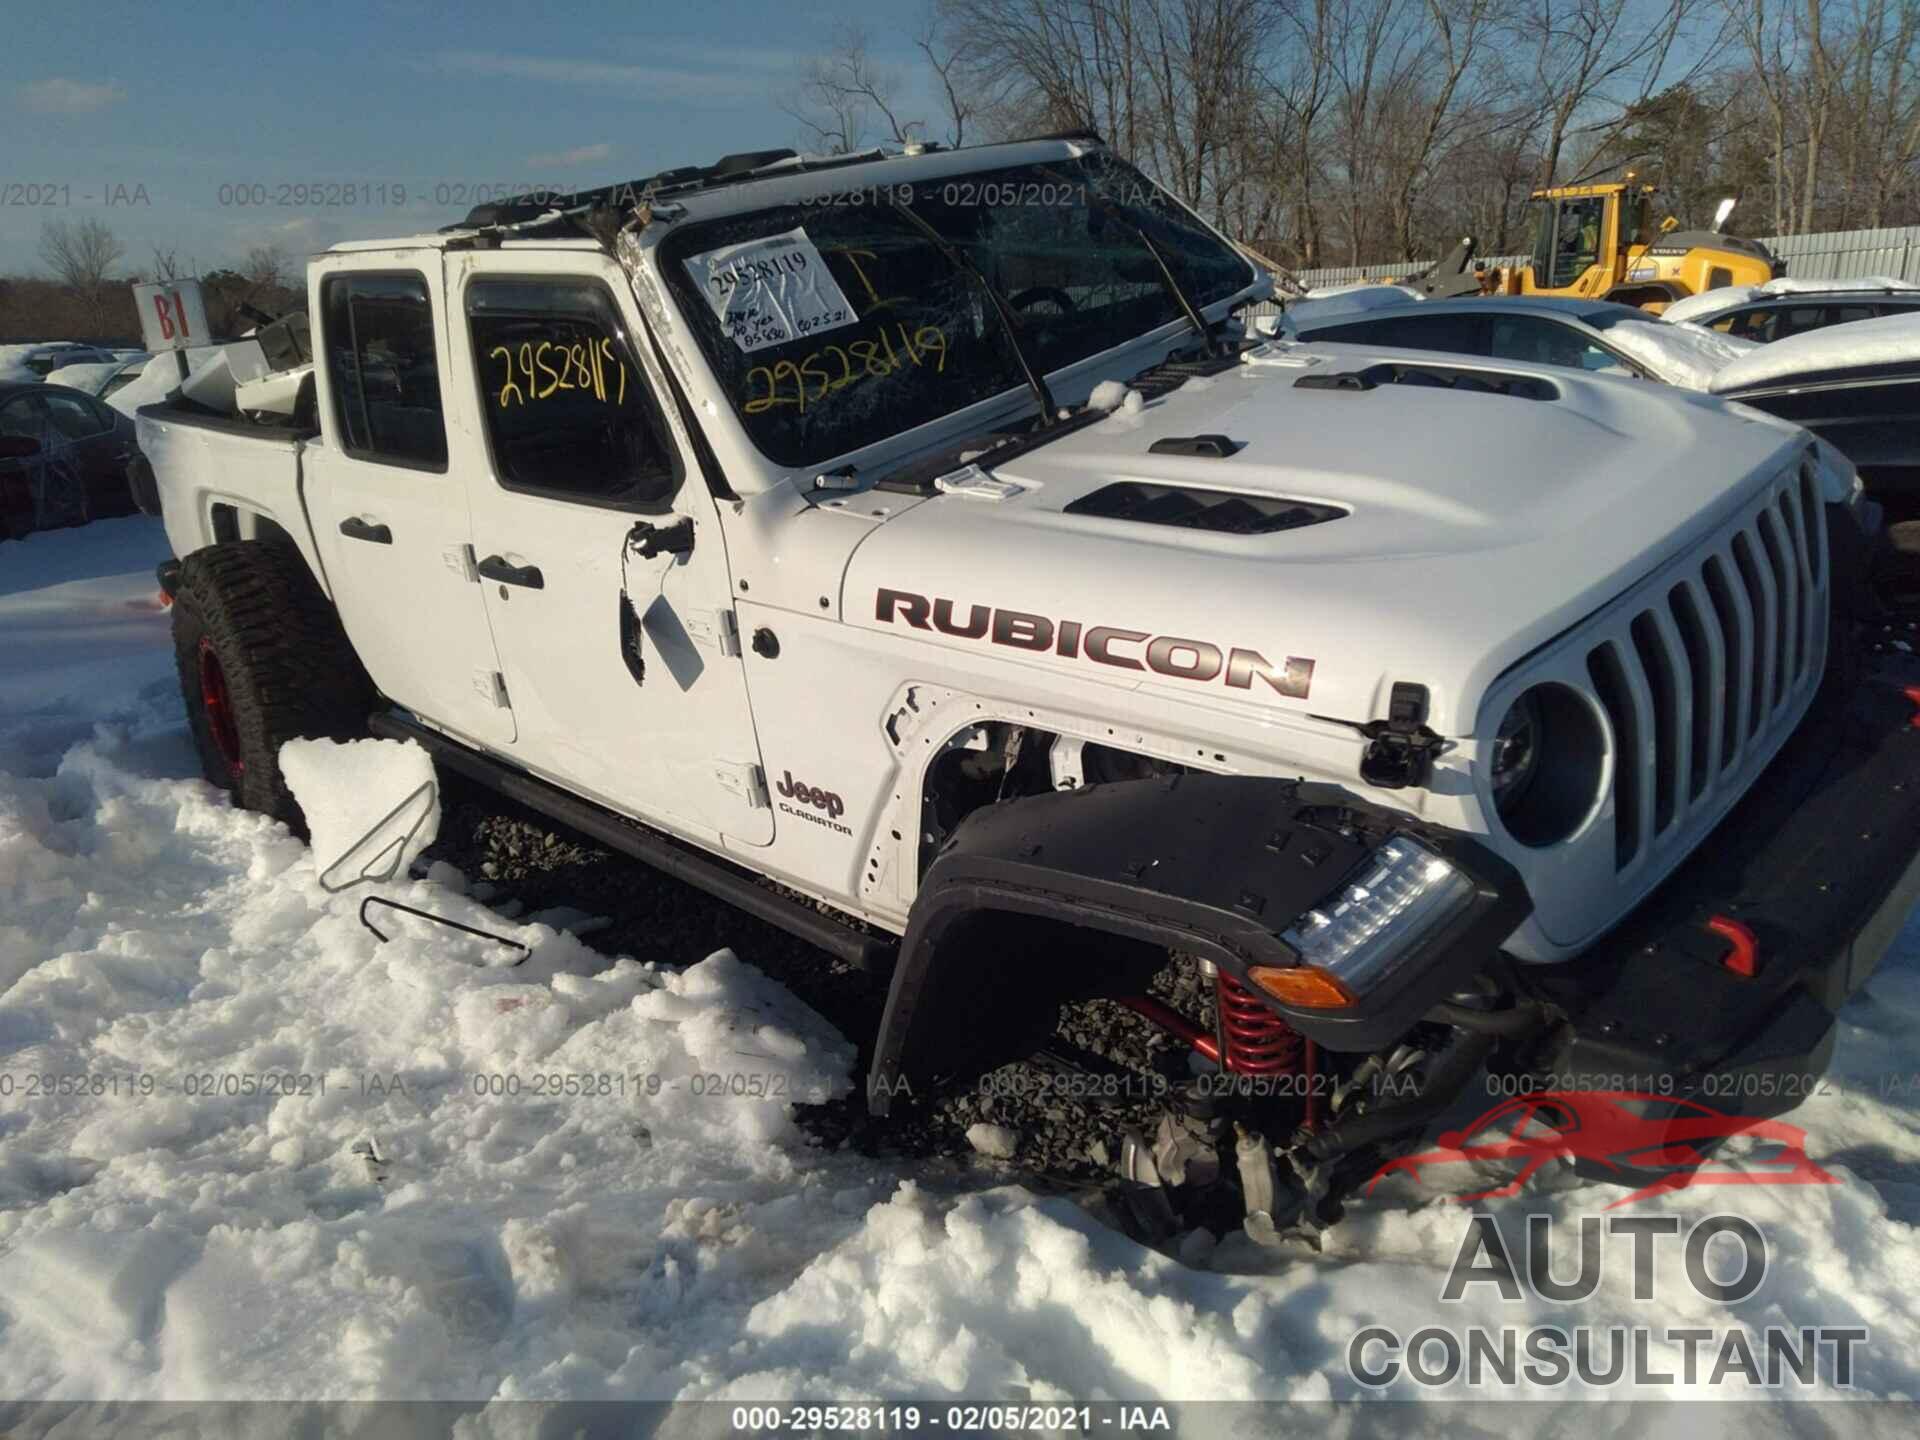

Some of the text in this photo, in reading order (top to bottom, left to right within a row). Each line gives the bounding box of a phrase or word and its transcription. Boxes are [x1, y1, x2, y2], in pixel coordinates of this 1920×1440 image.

[711, 251, 807, 295] 29528119
[490, 337, 625, 407] 29528119
[744, 322, 947, 414] 29528119
[875, 587, 1316, 701] RUBICON
[776, 770, 844, 819] Jeep
[779, 802, 853, 838] GLADIATOR
